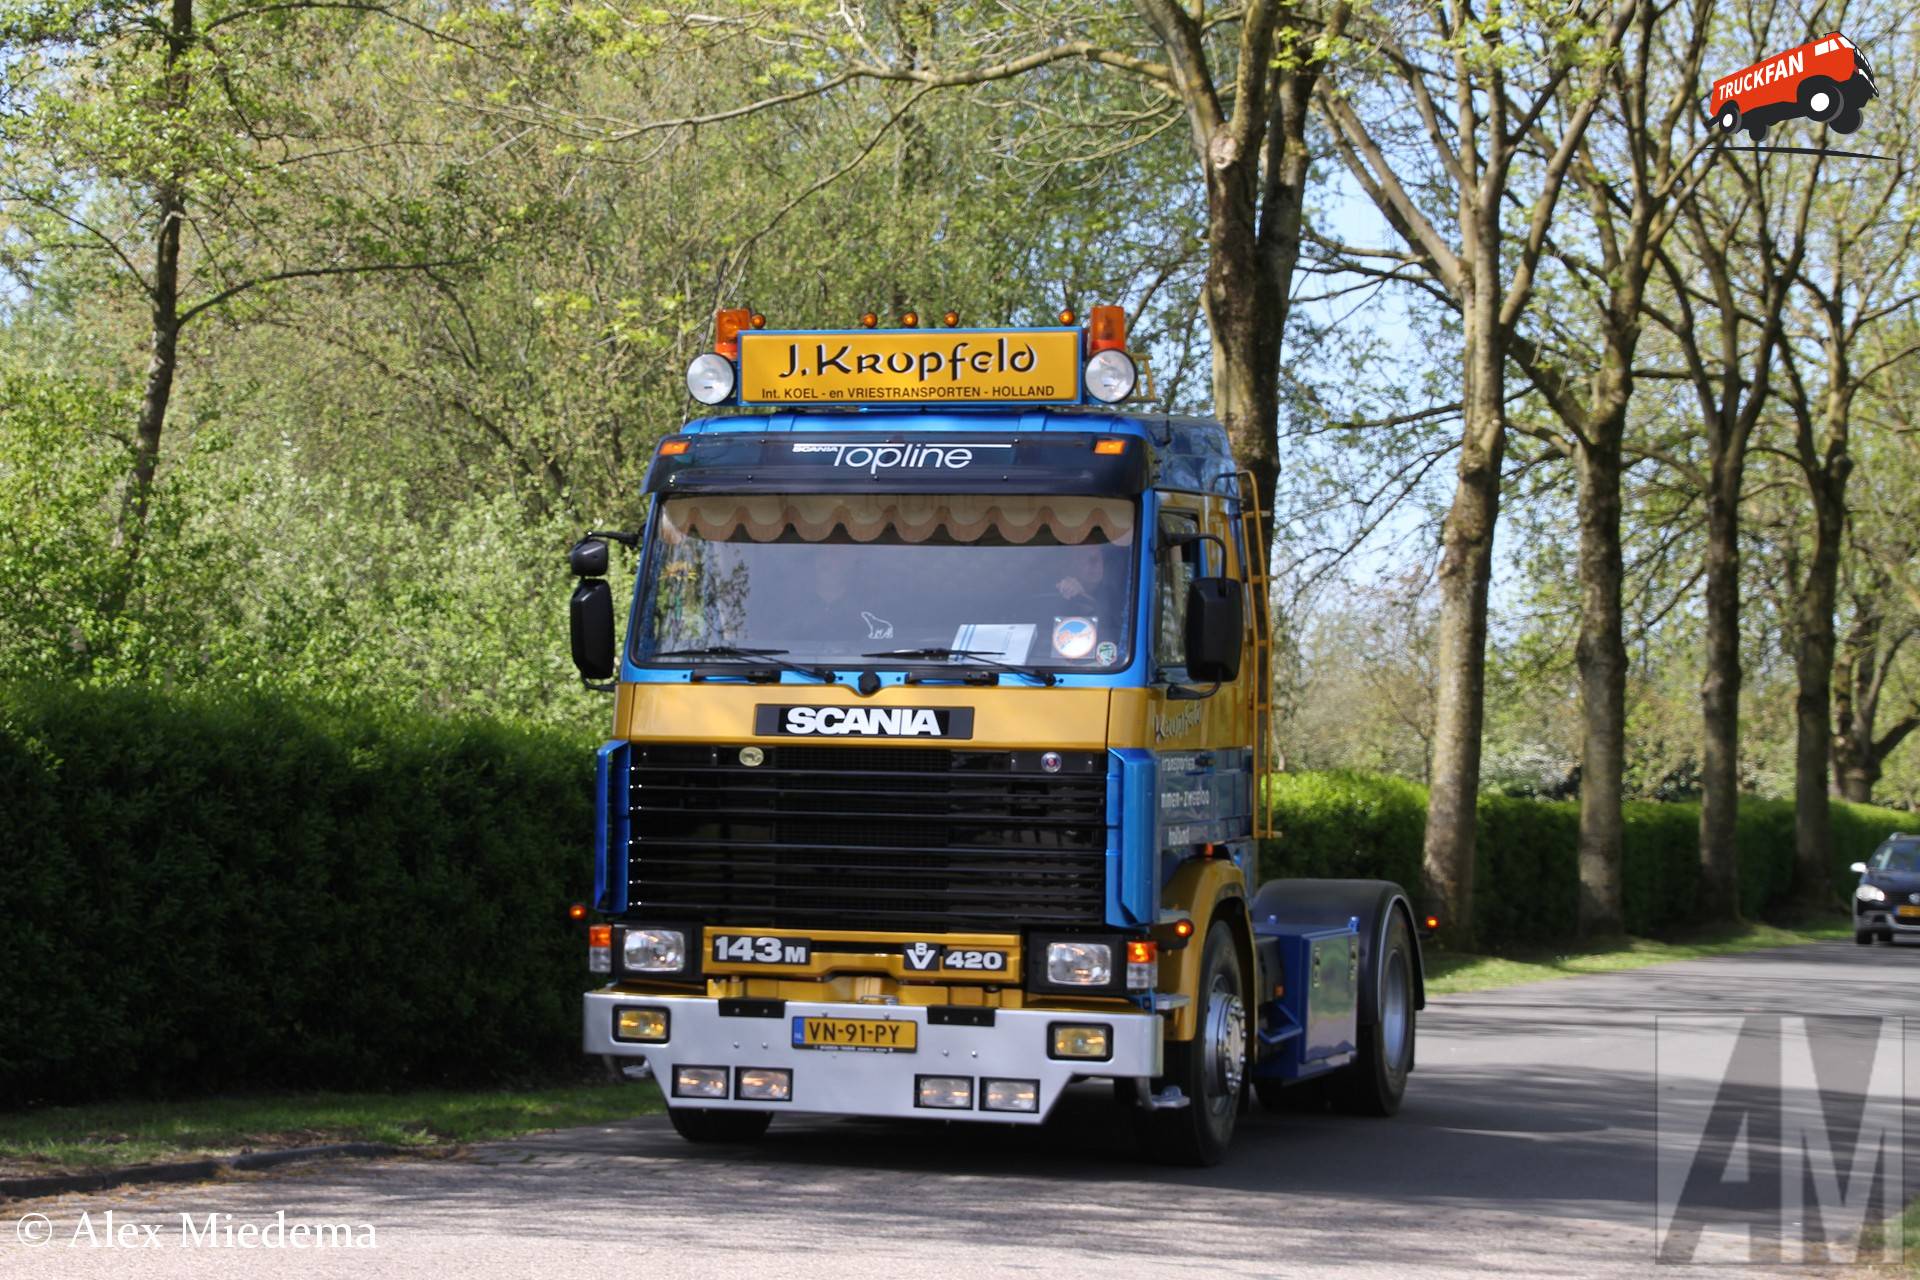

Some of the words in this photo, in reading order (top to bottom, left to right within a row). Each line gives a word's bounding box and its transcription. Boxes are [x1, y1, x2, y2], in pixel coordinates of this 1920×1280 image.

[762, 388, 780, 399] Int.
[784, 388, 818, 399] KOEL
[829, 389, 844, 399] en
[847, 387, 981, 399] VRIESTRANSPORTEN
[992, 386, 1055, 397] HOLLAND
[834, 444, 973, 475] Topline
[785, 707, 942, 736] SCANIA
[945, 951, 1003, 970] 420
[808, 1021, 900, 1044] VN-91-PY
